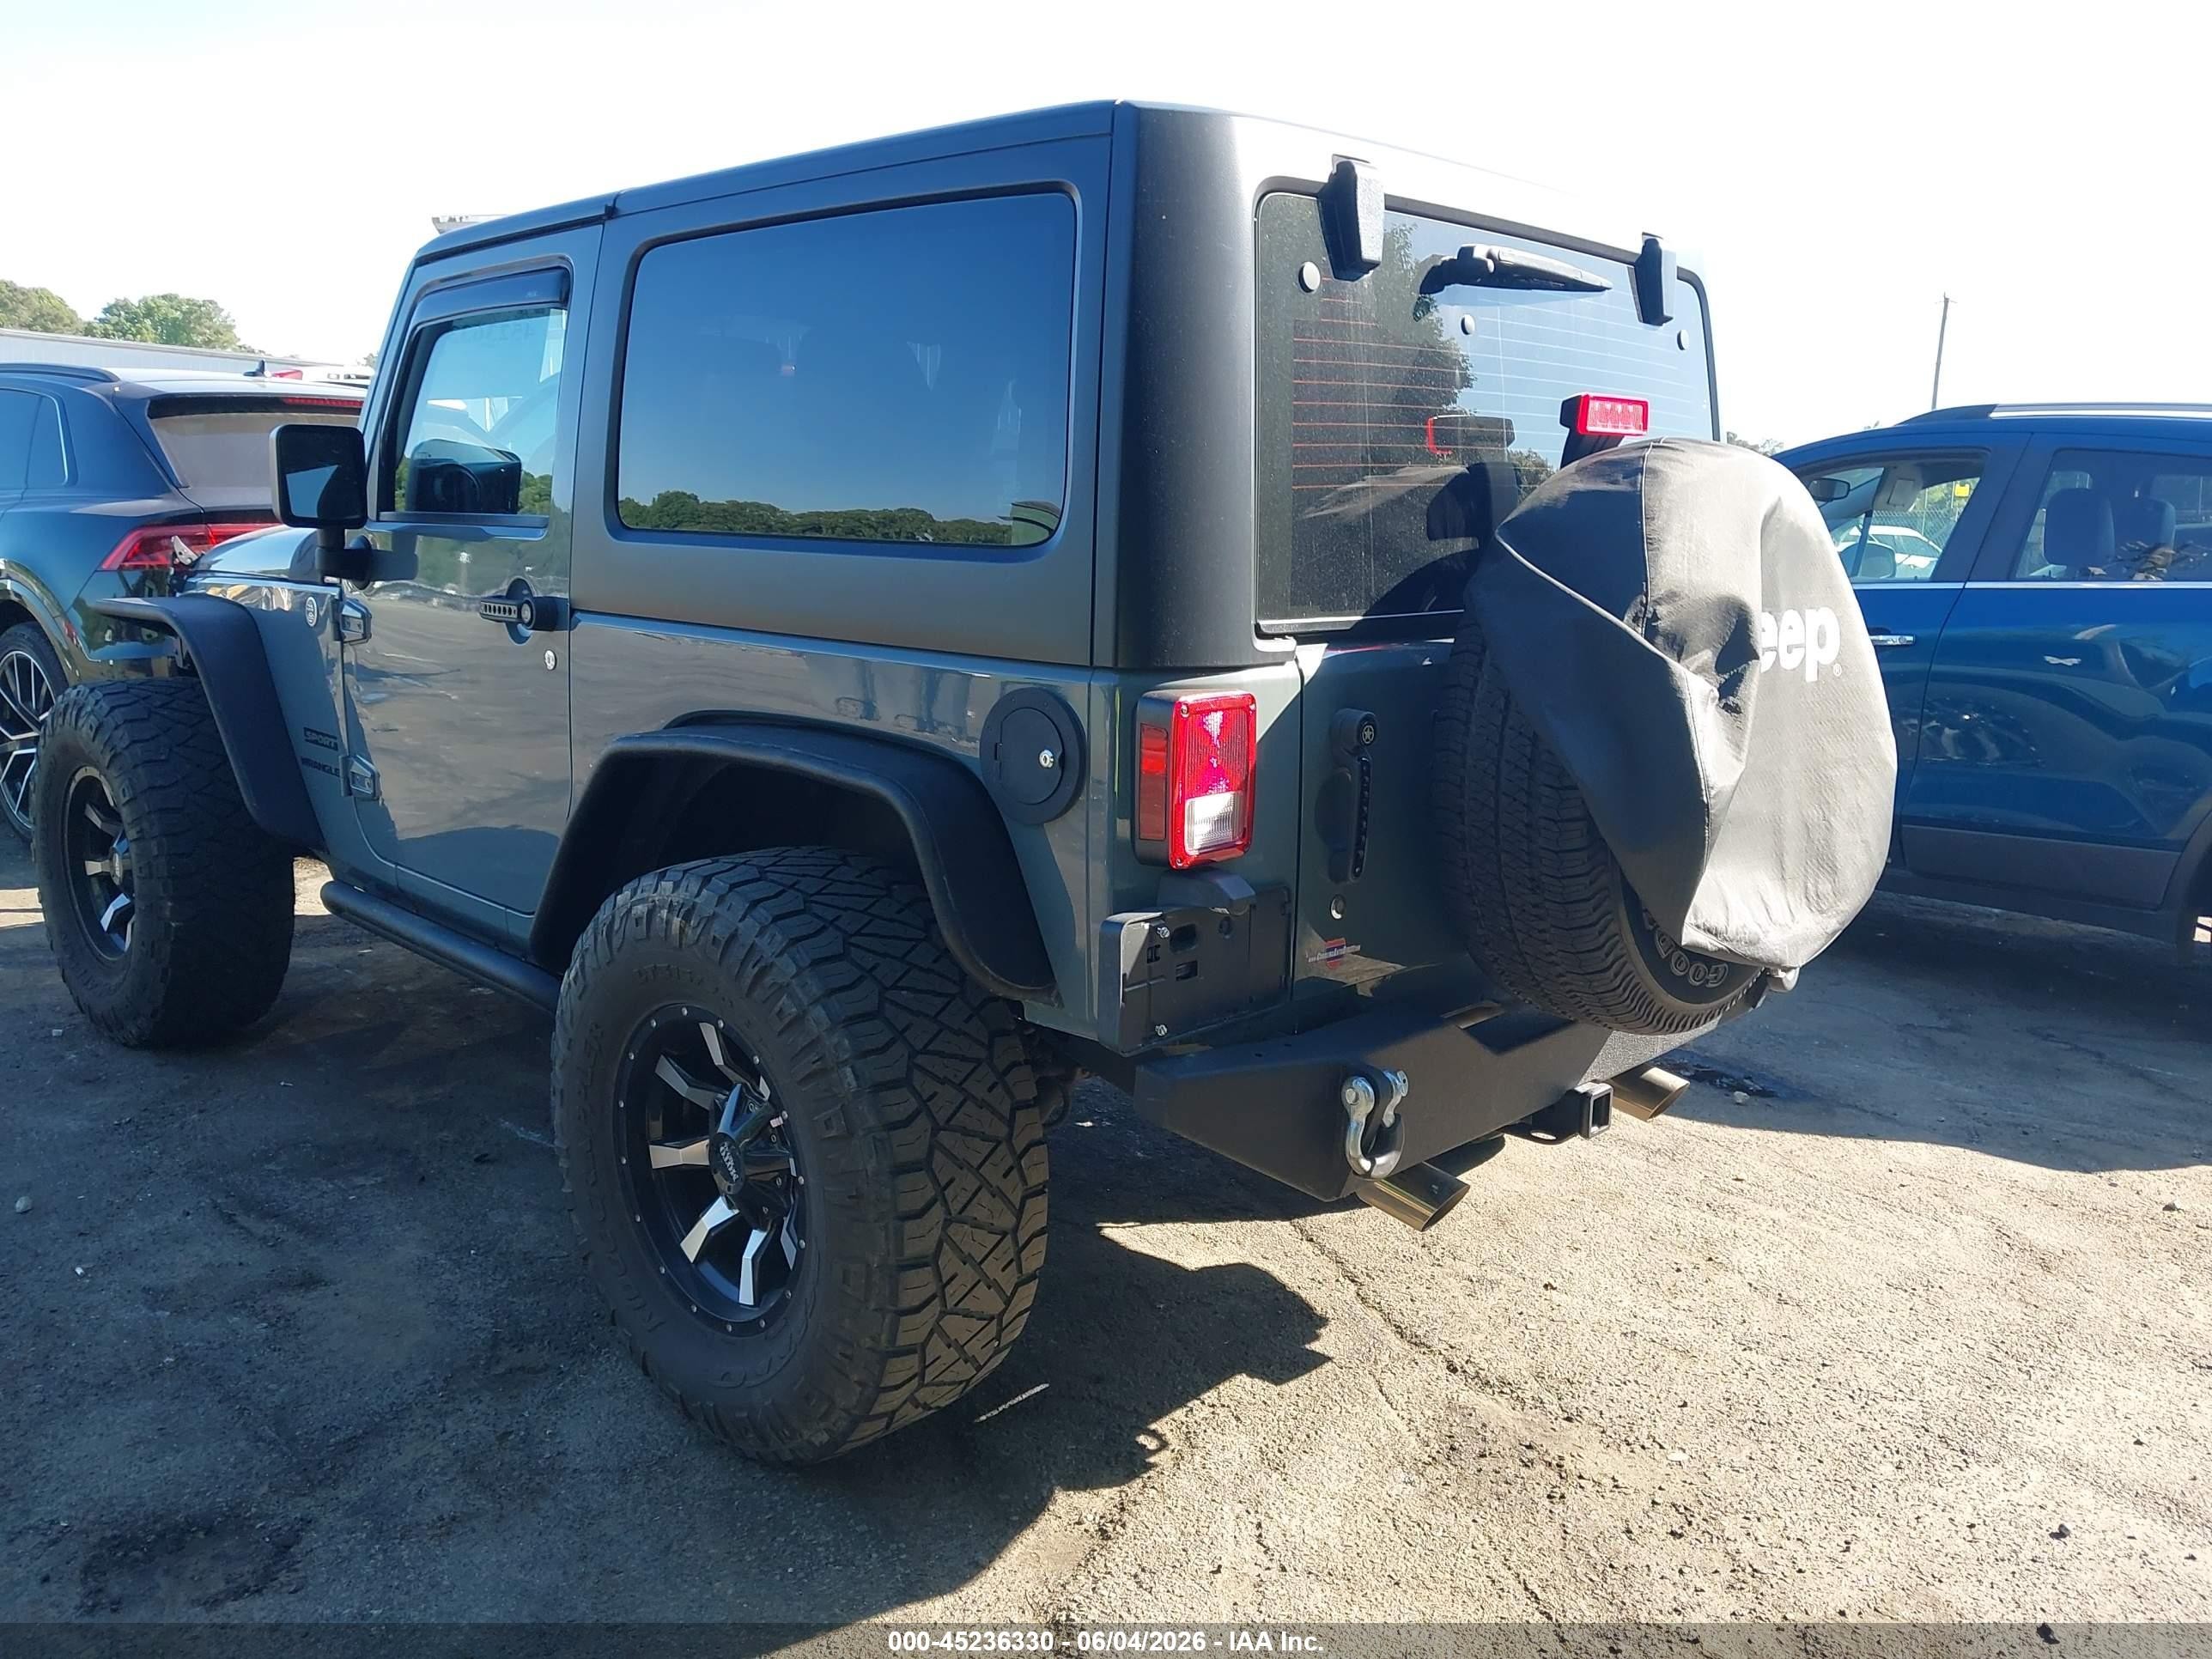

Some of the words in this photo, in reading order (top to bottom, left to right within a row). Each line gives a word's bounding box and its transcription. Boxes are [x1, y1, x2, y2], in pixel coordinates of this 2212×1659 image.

[1760, 606, 1840, 683] eep
[305, 729, 339, 749] SPORT
[301, 757, 341, 778] WRANGLE
